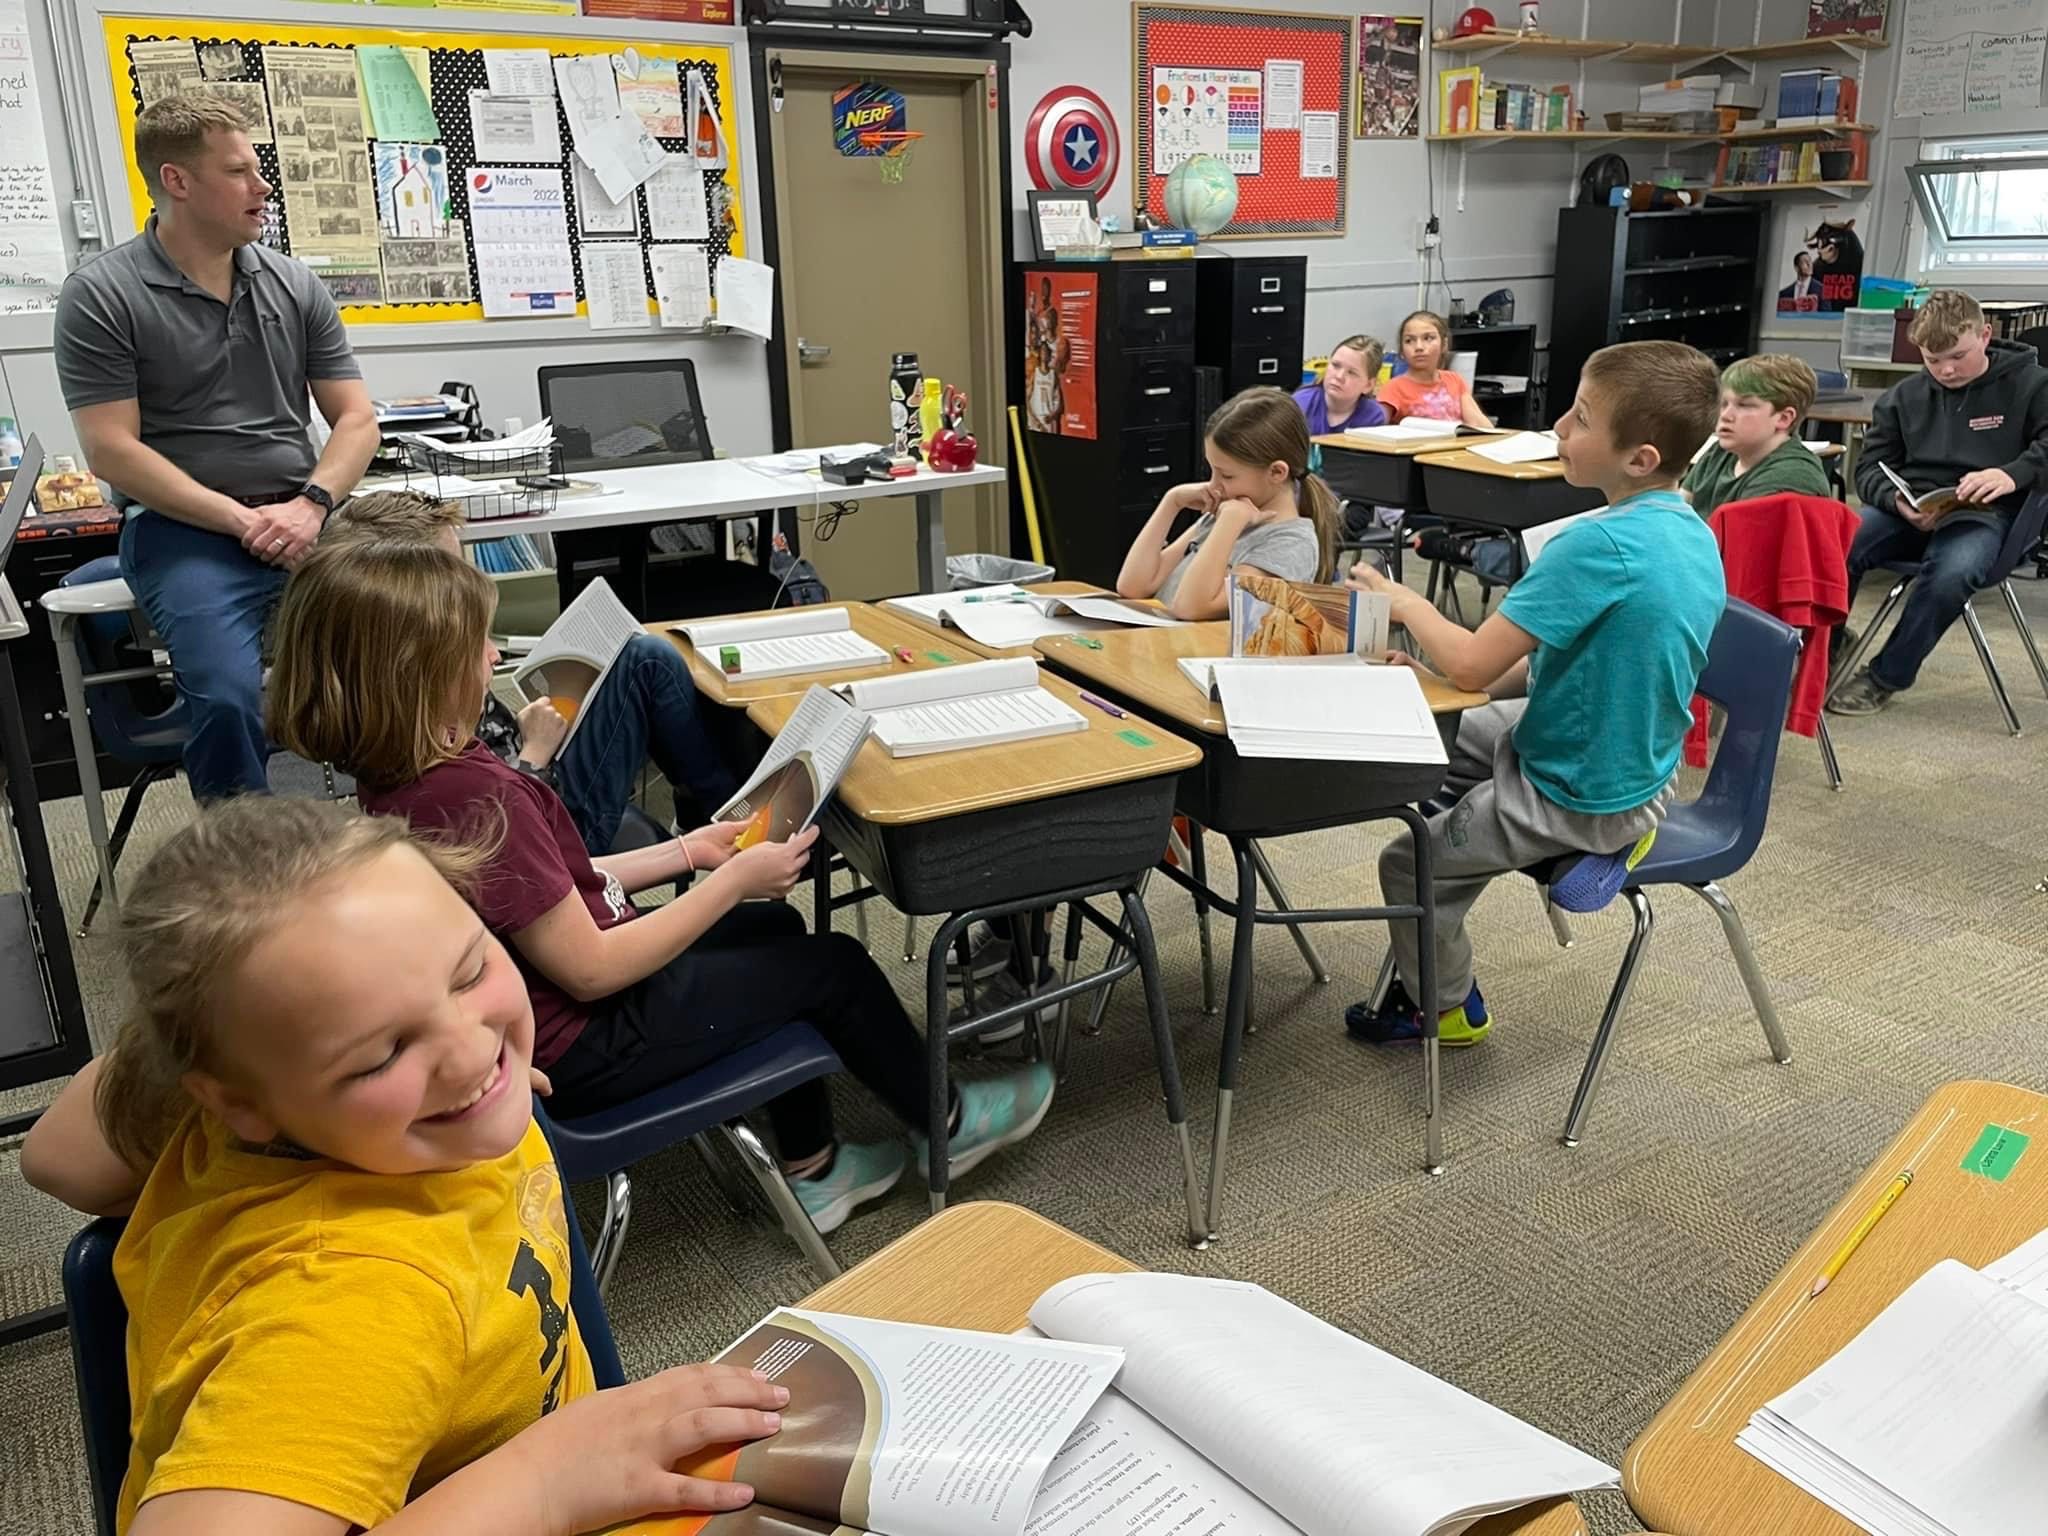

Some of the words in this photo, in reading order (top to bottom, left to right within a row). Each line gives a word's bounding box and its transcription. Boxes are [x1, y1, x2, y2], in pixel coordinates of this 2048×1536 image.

[845, 104, 894, 129] NERF
[496, 174, 533, 186] March
[532, 189, 560, 201] 2022
[1823, 274, 1856, 284] READ
[1823, 286, 1853, 300] BIG
